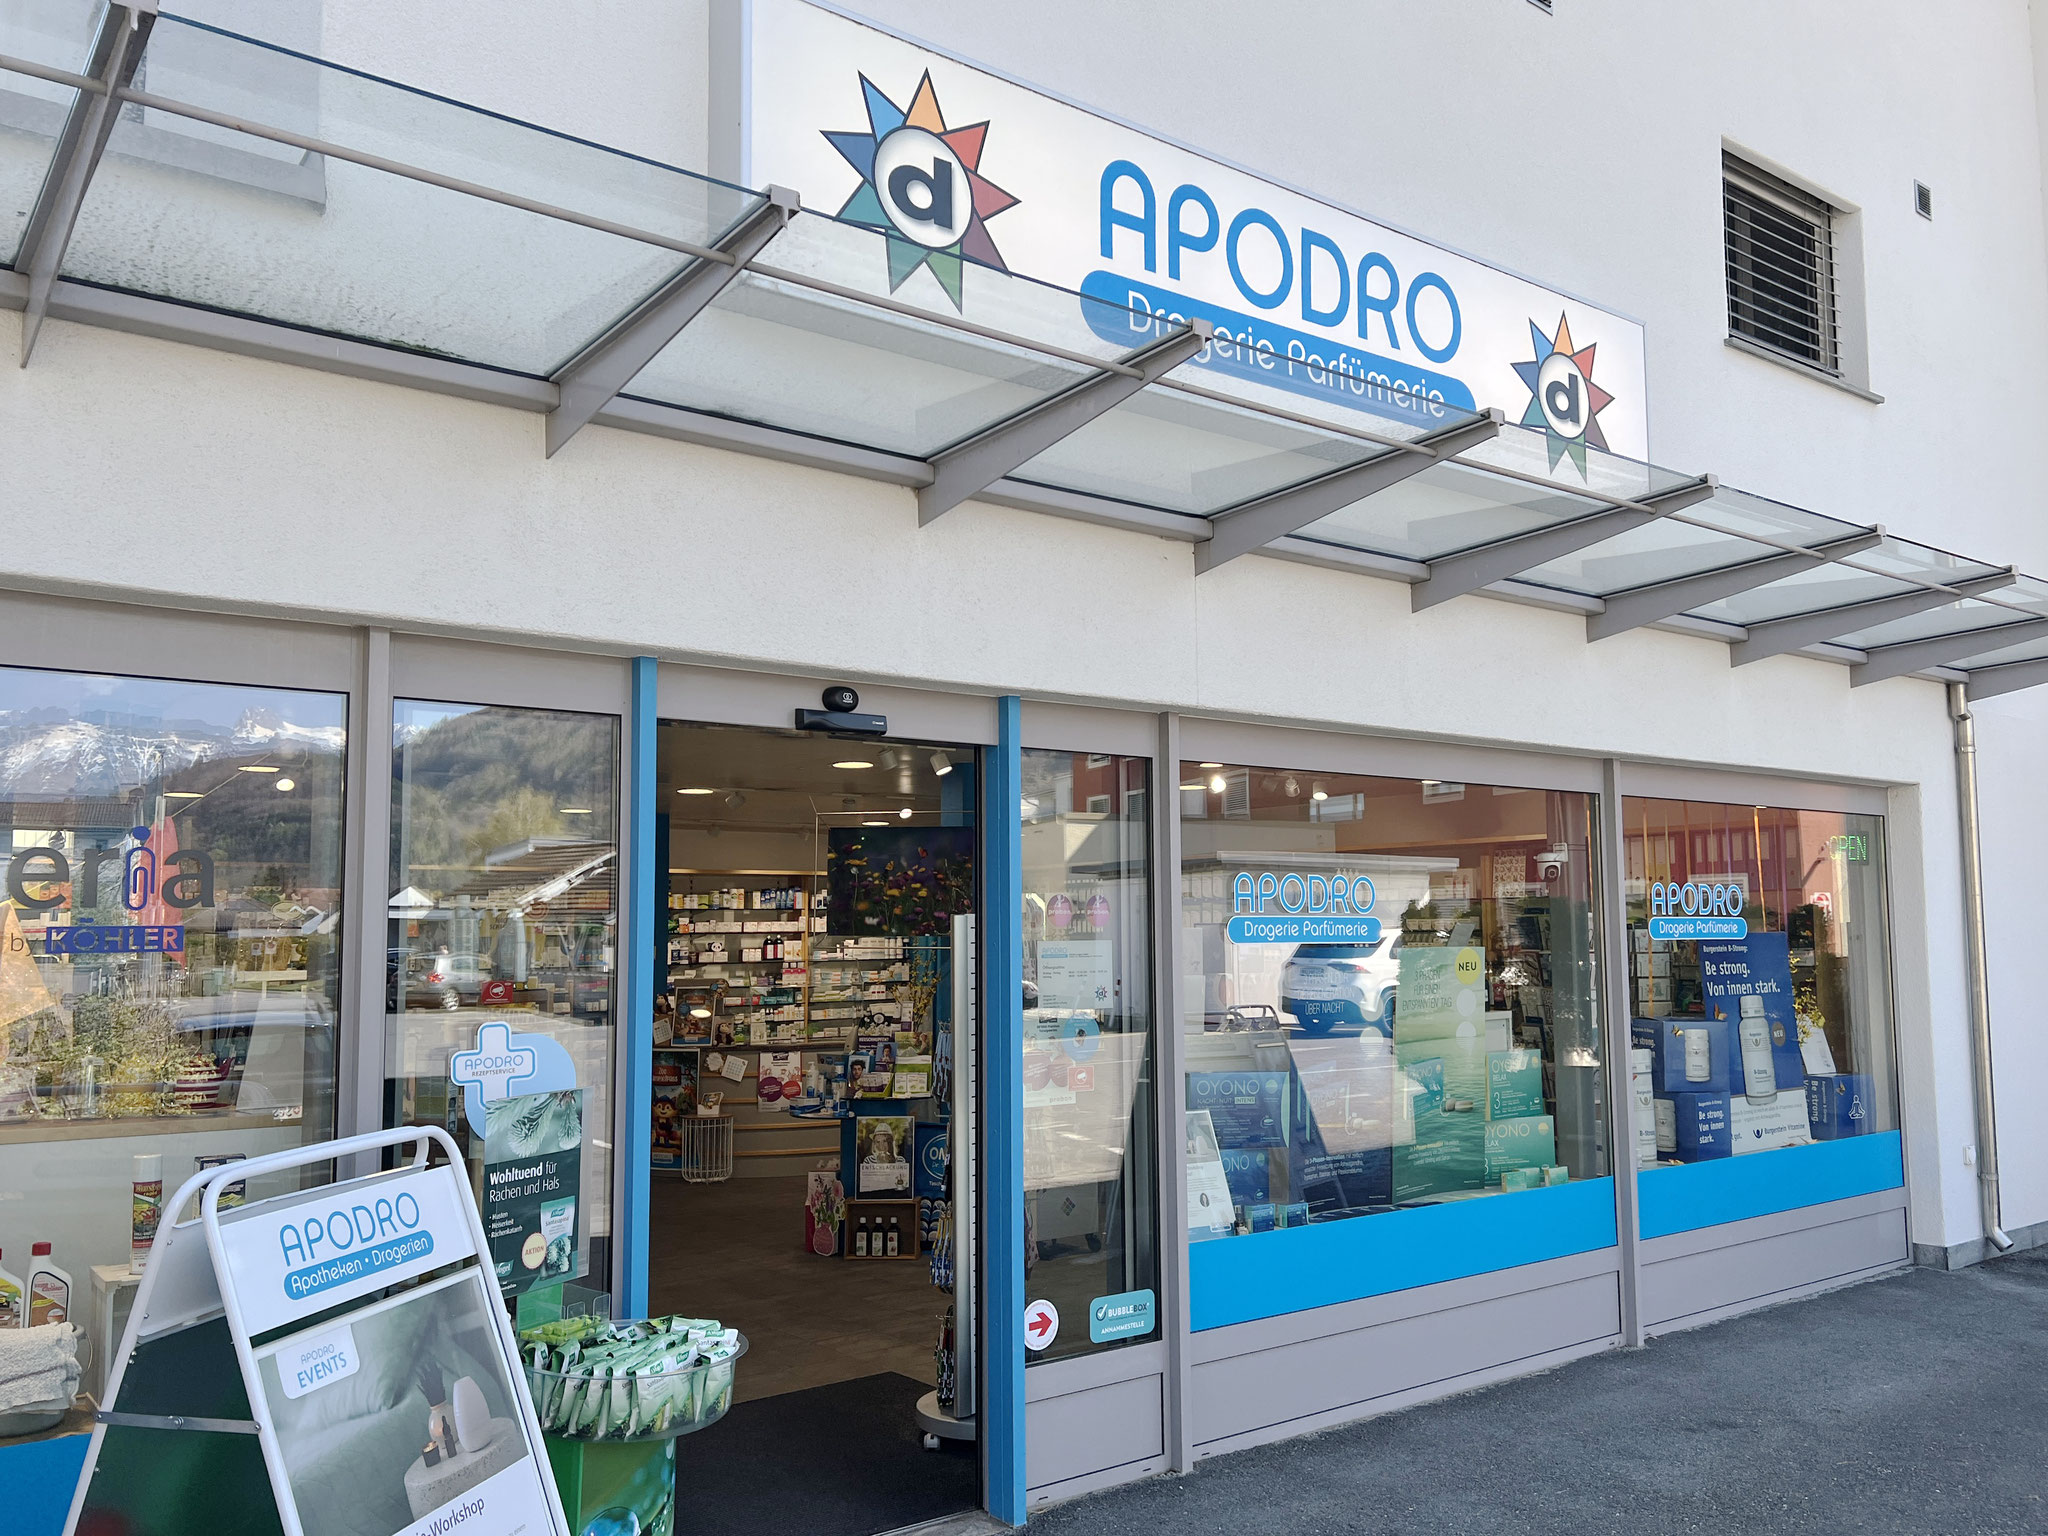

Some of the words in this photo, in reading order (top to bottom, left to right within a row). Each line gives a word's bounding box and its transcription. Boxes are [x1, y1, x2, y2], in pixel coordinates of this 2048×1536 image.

[888, 156, 952, 230] d
[1100, 159, 1462, 364] APODRO
[1288, 340, 1446, 418] Parfümerie
[1545, 373, 1579, 425] d
[1830, 835, 1866, 861] OPEN
[1234, 872, 1377, 914] APODRO
[1651, 882, 1743, 916] APODRO
[10, 932, 34, 957] by
[50, 917, 178, 951] KÖHLER
[1244, 921, 1300, 941] Drogerie
[1303, 920, 1369, 937] Parfümerie
[1660, 921, 1694, 937] Drogerie
[1696, 921, 1738, 934] Parfümerie
[1703, 945, 1728, 954] Burgerstein
[1419, 969, 1440, 980] PHASEN
[1458, 962, 1476, 971] NEU
[1705, 961, 1716, 975] Be
[1720, 961, 1750, 978] strong.
[1707, 982, 1724, 996] Von
[1727, 980, 1752, 995] innen
[1755, 978, 1780, 993] stark.
[1304, 1001, 1320, 1015] ÜBER
[1321, 1001, 1344, 1014] NACHT
[1440, 997, 1452, 1007] TAG
[464, 1055, 524, 1071] APODRO
[472, 1067, 516, 1077] REZEPTSERVICE
[1196, 1079, 1260, 1095] OYONO
[1811, 1080, 1818, 1091] Be
[1493, 1092, 1500, 1109] 3
[1699, 1111, 1706, 1120] Be
[1707, 1110, 1724, 1119] strong.
[1811, 1095, 1819, 1124] strong.
[1699, 1123, 1709, 1132] Von
[1711, 1121, 1724, 1130] innen
[1764, 1126, 1787, 1135] Burgerstein
[1788, 1123, 1805, 1131] Vitamine
[1700, 1133, 1714, 1144] stark.
[489, 1162, 543, 1185] Wohltuend
[545, 1160, 557, 1175] für
[489, 1185, 521, 1202] Rachen
[524, 1181, 540, 1195] und
[542, 1176, 560, 1192] Hals
[279, 1192, 420, 1267] APODRO
[525, 1246, 544, 1256] AKTION
[291, 1258, 362, 1295] Apotheken
[371, 1236, 429, 1265] Drogerien
[1101, 1321, 1145, 1335] ANNAHMESTELLE
[300, 1343, 335, 1365] APODRO
[297, 1351, 347, 1389] EVENTS
[415, 1498, 485, 1536] -Workshop
